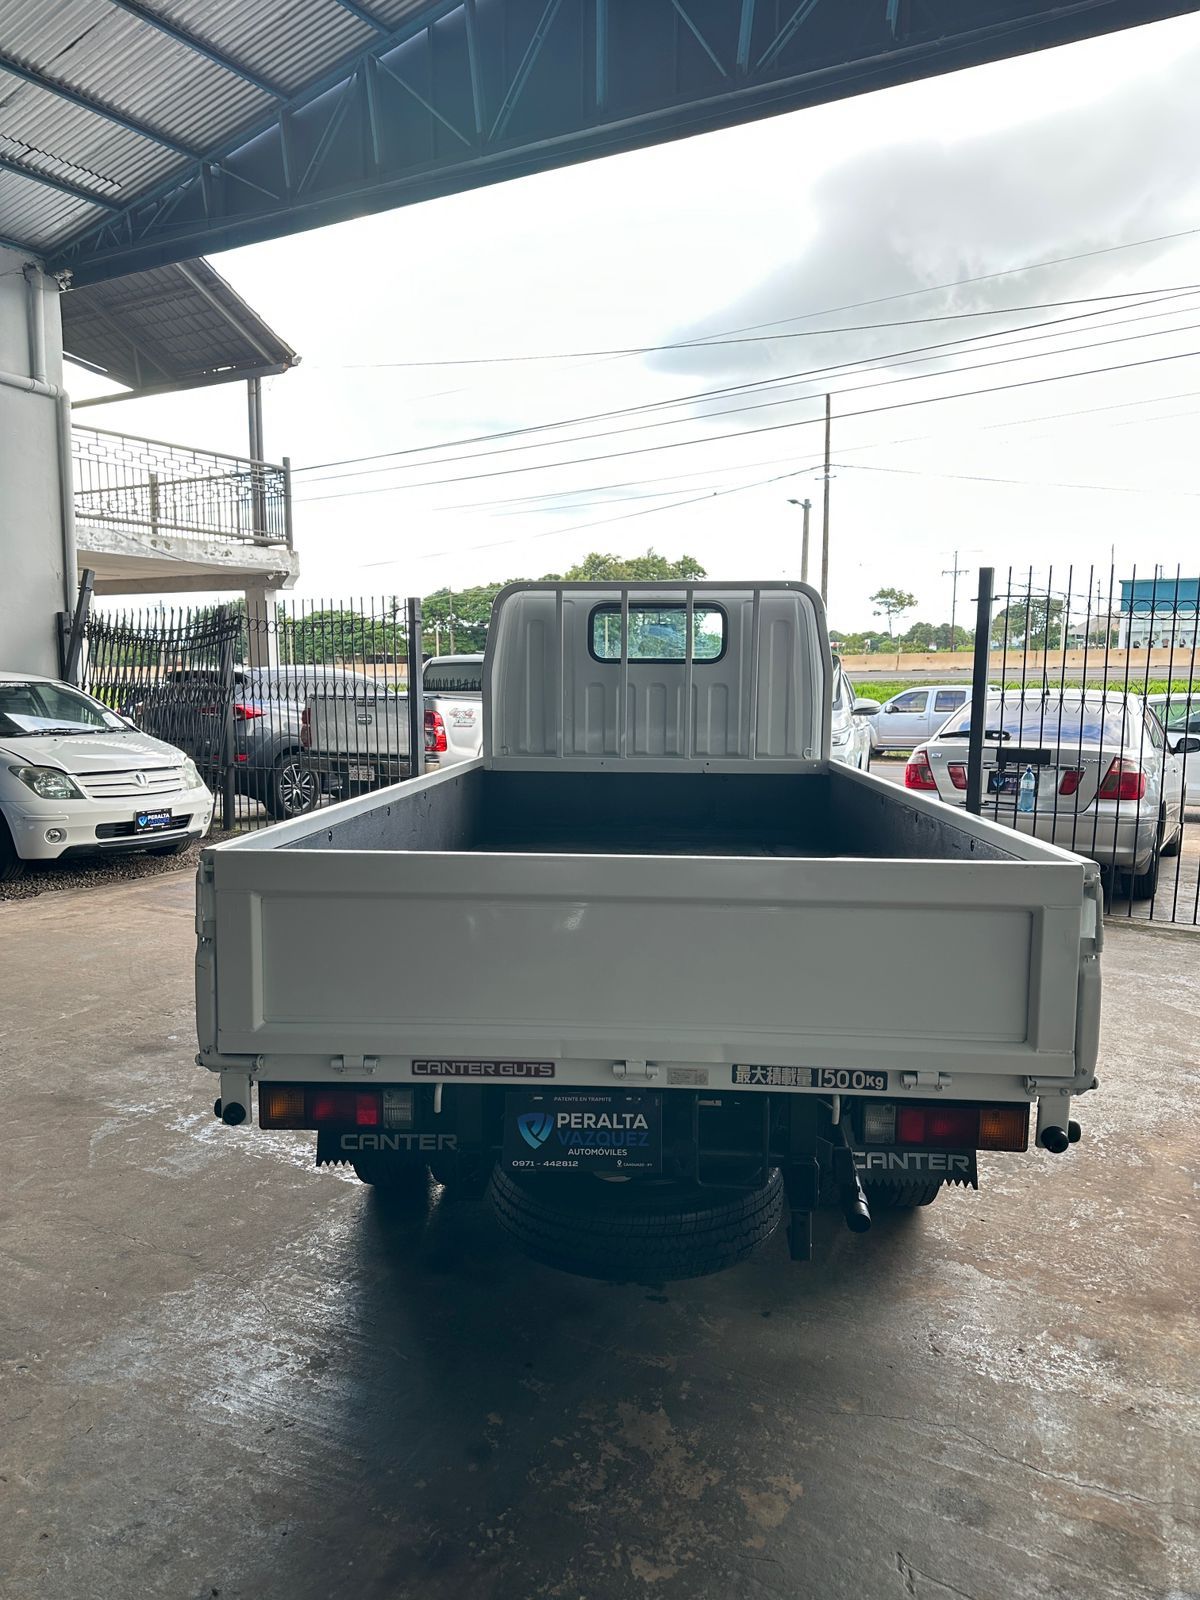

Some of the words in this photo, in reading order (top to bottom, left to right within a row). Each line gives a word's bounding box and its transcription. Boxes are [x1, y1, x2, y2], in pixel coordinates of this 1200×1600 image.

[414, 1062, 495, 1075] CANTER
[499, 1063, 552, 1076] GUTS
[557, 1113, 649, 1130] PERALTA
[340, 1133, 457, 1151] CANTER
[557, 1131, 649, 1147] VAZQUEZ
[568, 1147, 628, 1156] AUTOMÓVILES
